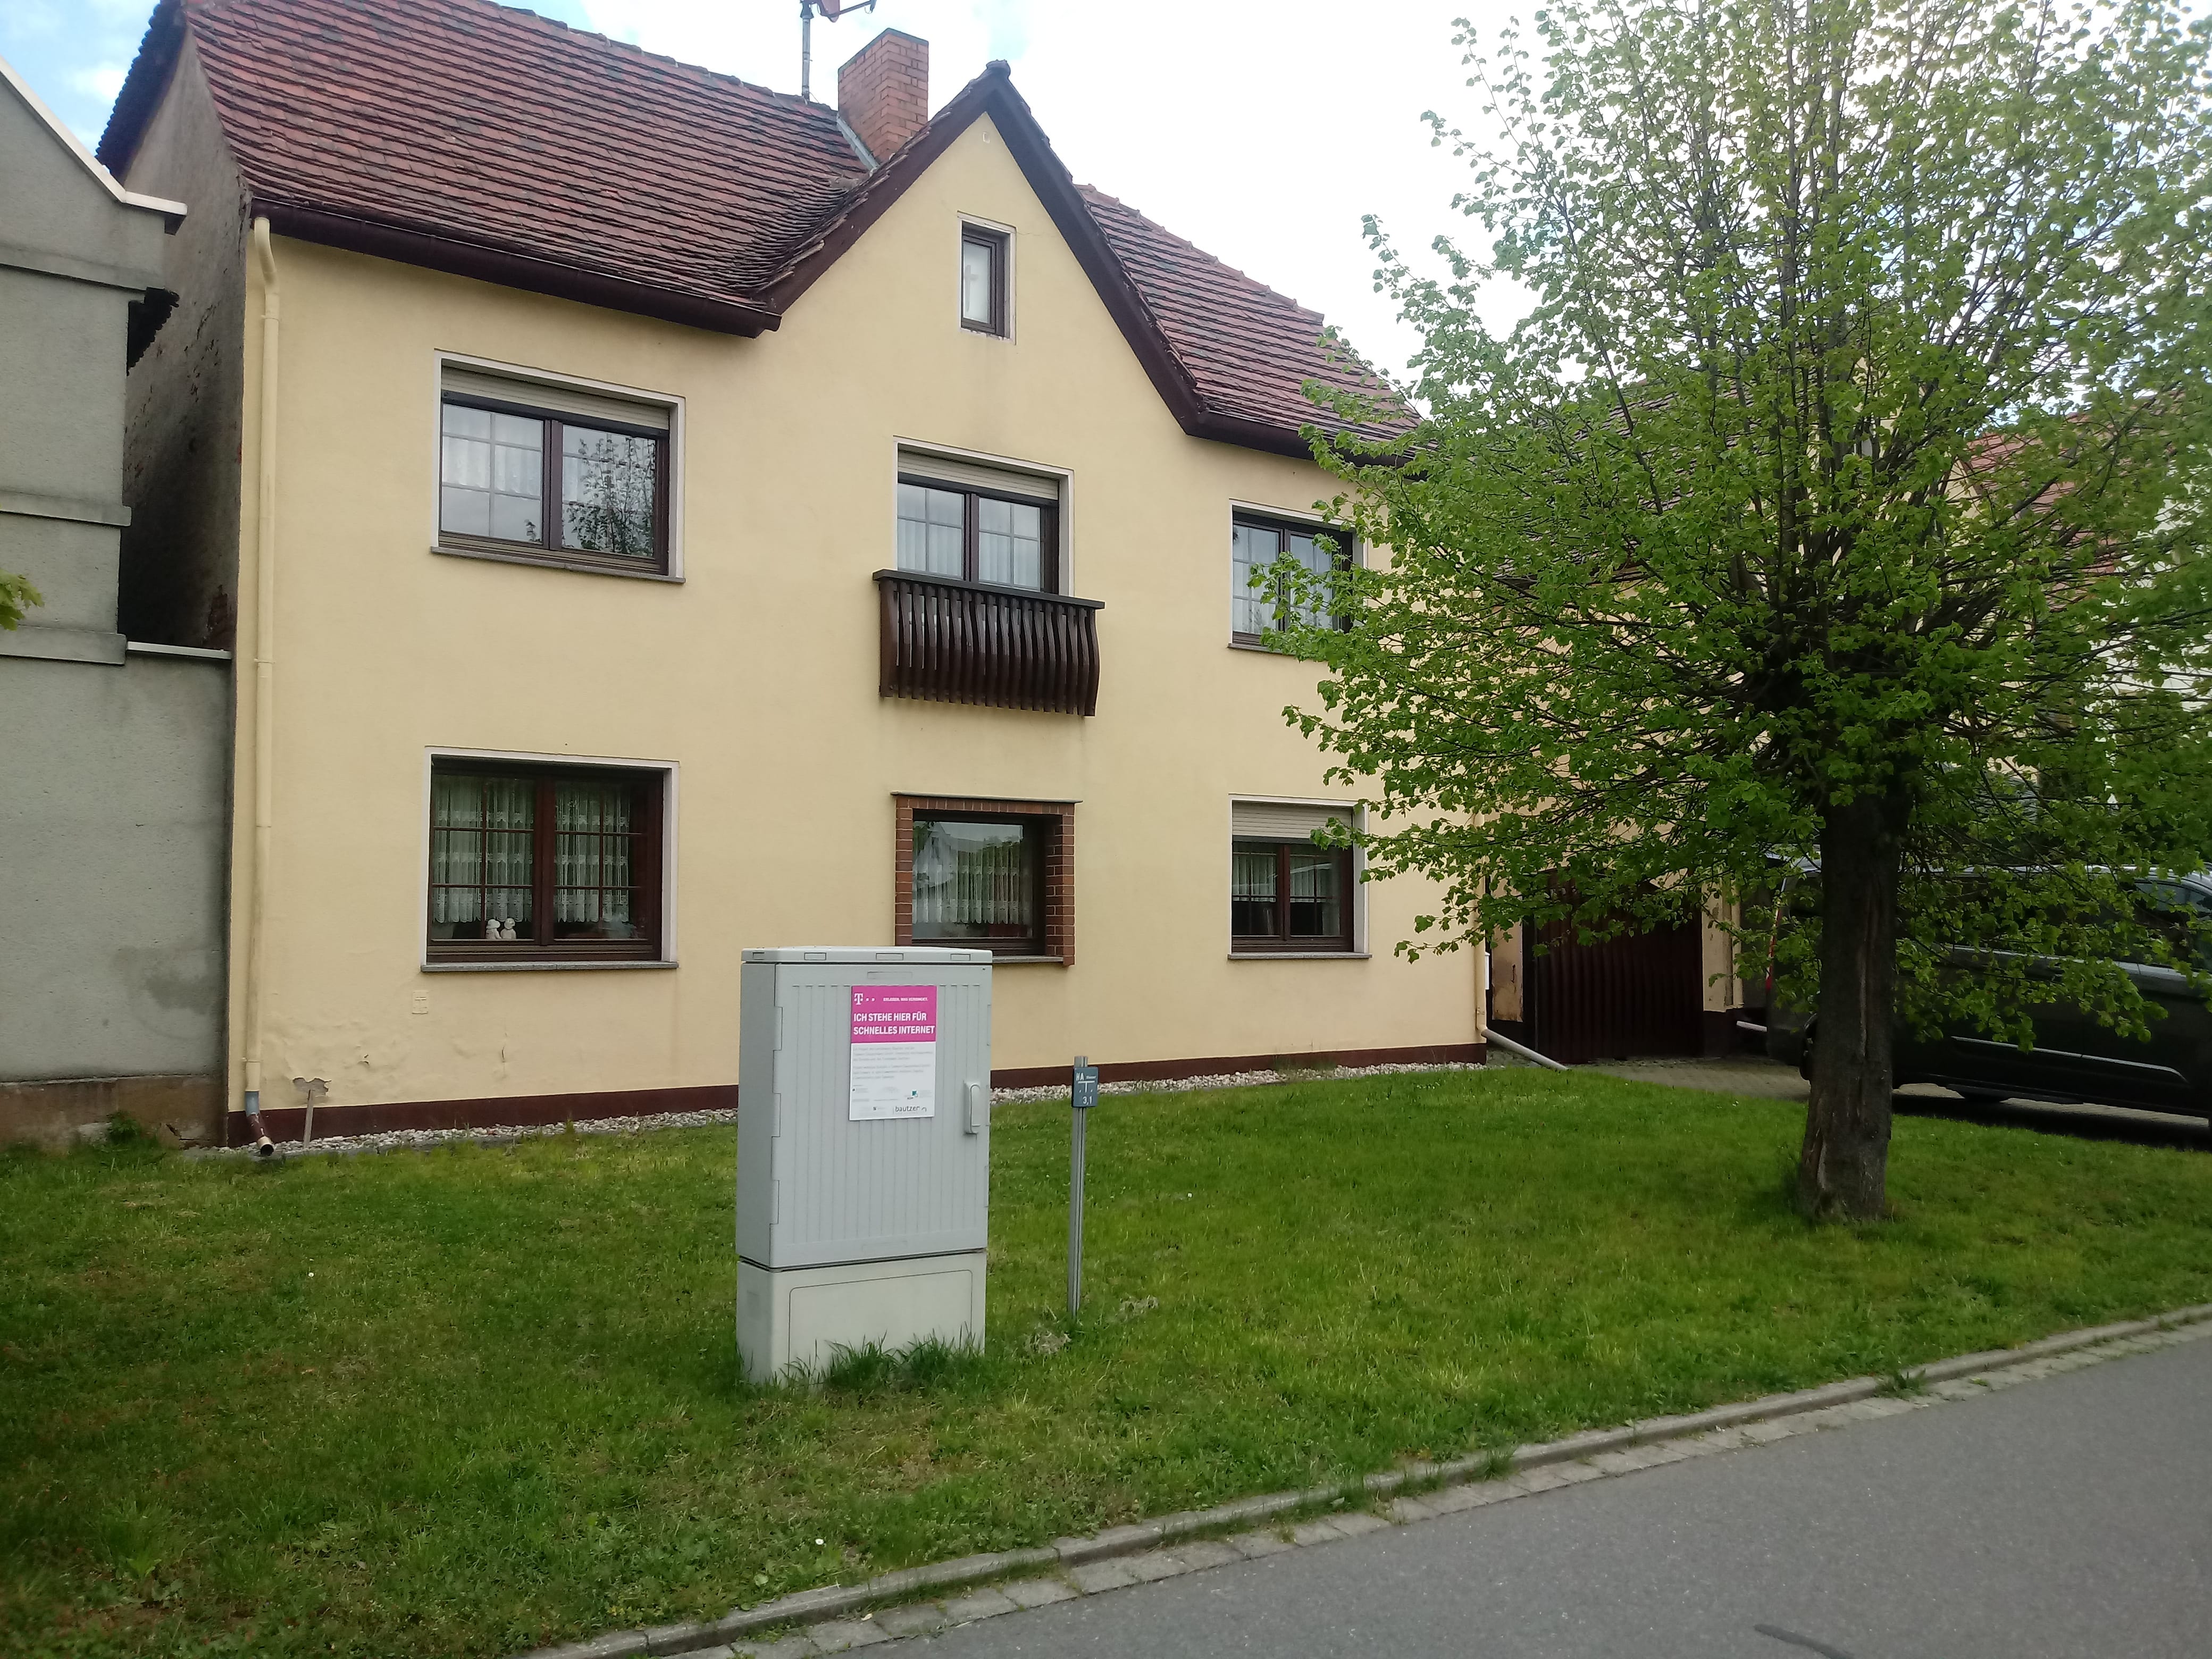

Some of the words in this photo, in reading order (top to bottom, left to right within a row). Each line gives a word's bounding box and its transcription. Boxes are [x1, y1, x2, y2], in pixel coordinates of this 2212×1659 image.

[853, 1013, 867, 1021] ICH
[868, 1013, 892, 1021] STEHE
[893, 1012, 911, 1021] HIER
[912, 1011, 926, 1021] FÜR
[853, 1026, 898, 1035] SCHNELLES
[899, 1026, 935, 1034] INTERNET
[1076, 1073, 1084, 1081] HA
[1083, 1096, 1092, 1105] 3,1
